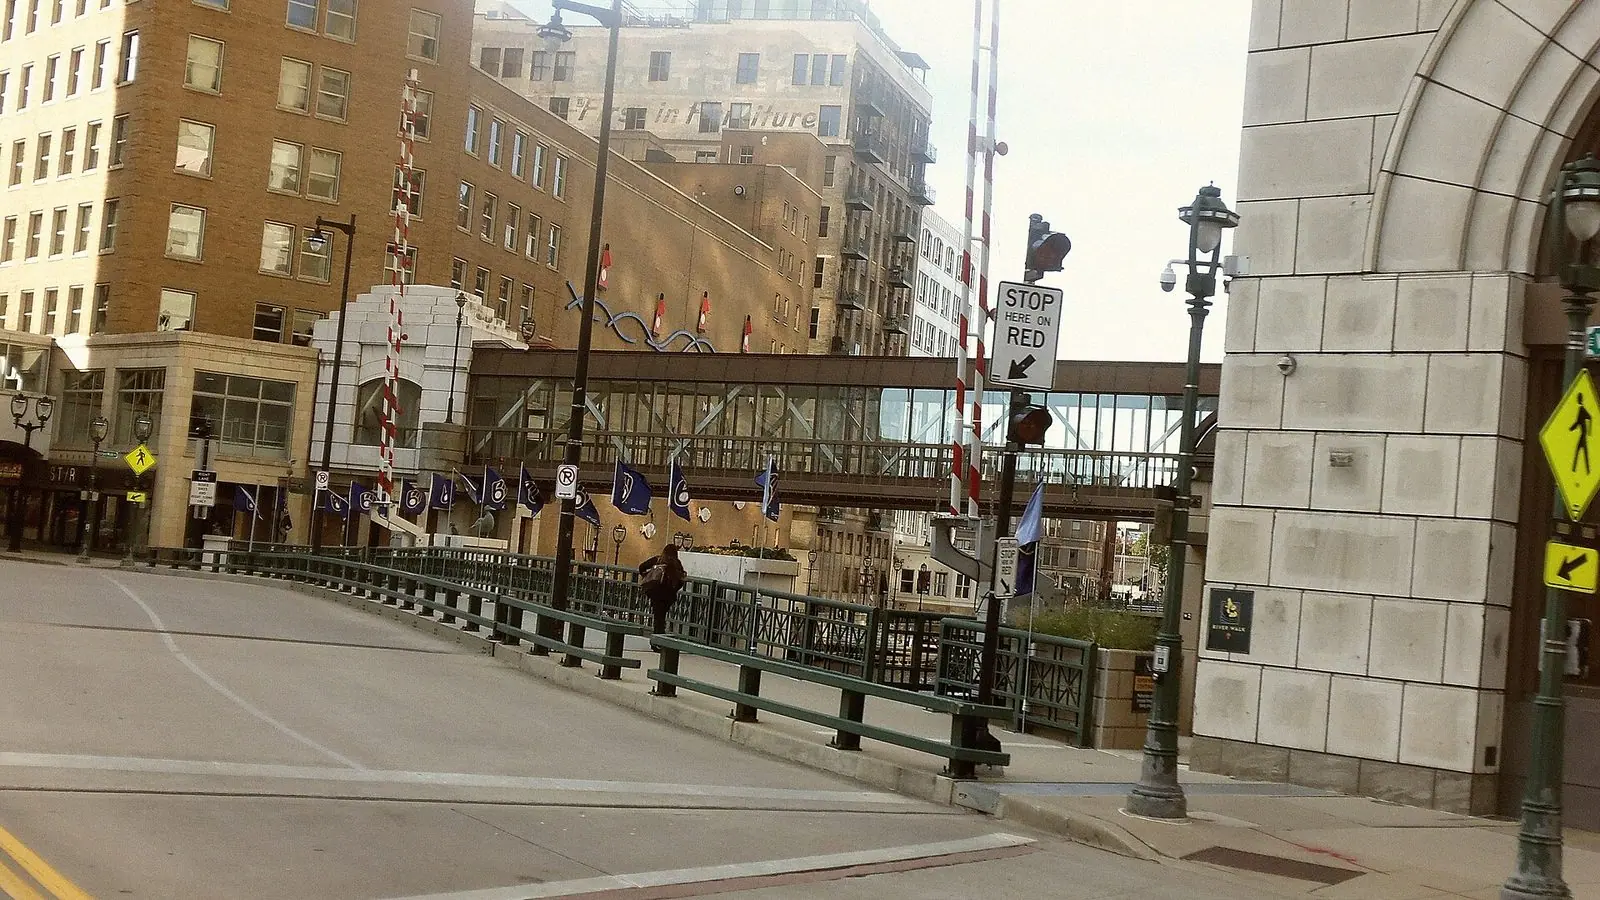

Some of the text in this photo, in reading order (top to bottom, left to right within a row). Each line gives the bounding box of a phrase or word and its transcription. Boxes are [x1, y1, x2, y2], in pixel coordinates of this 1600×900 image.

[1005, 288, 1054, 311] STOP
[1005, 311, 1051, 326] HERE ON
[1007, 326, 1045, 348] RED
[1000, 549, 1016, 559] STOP
